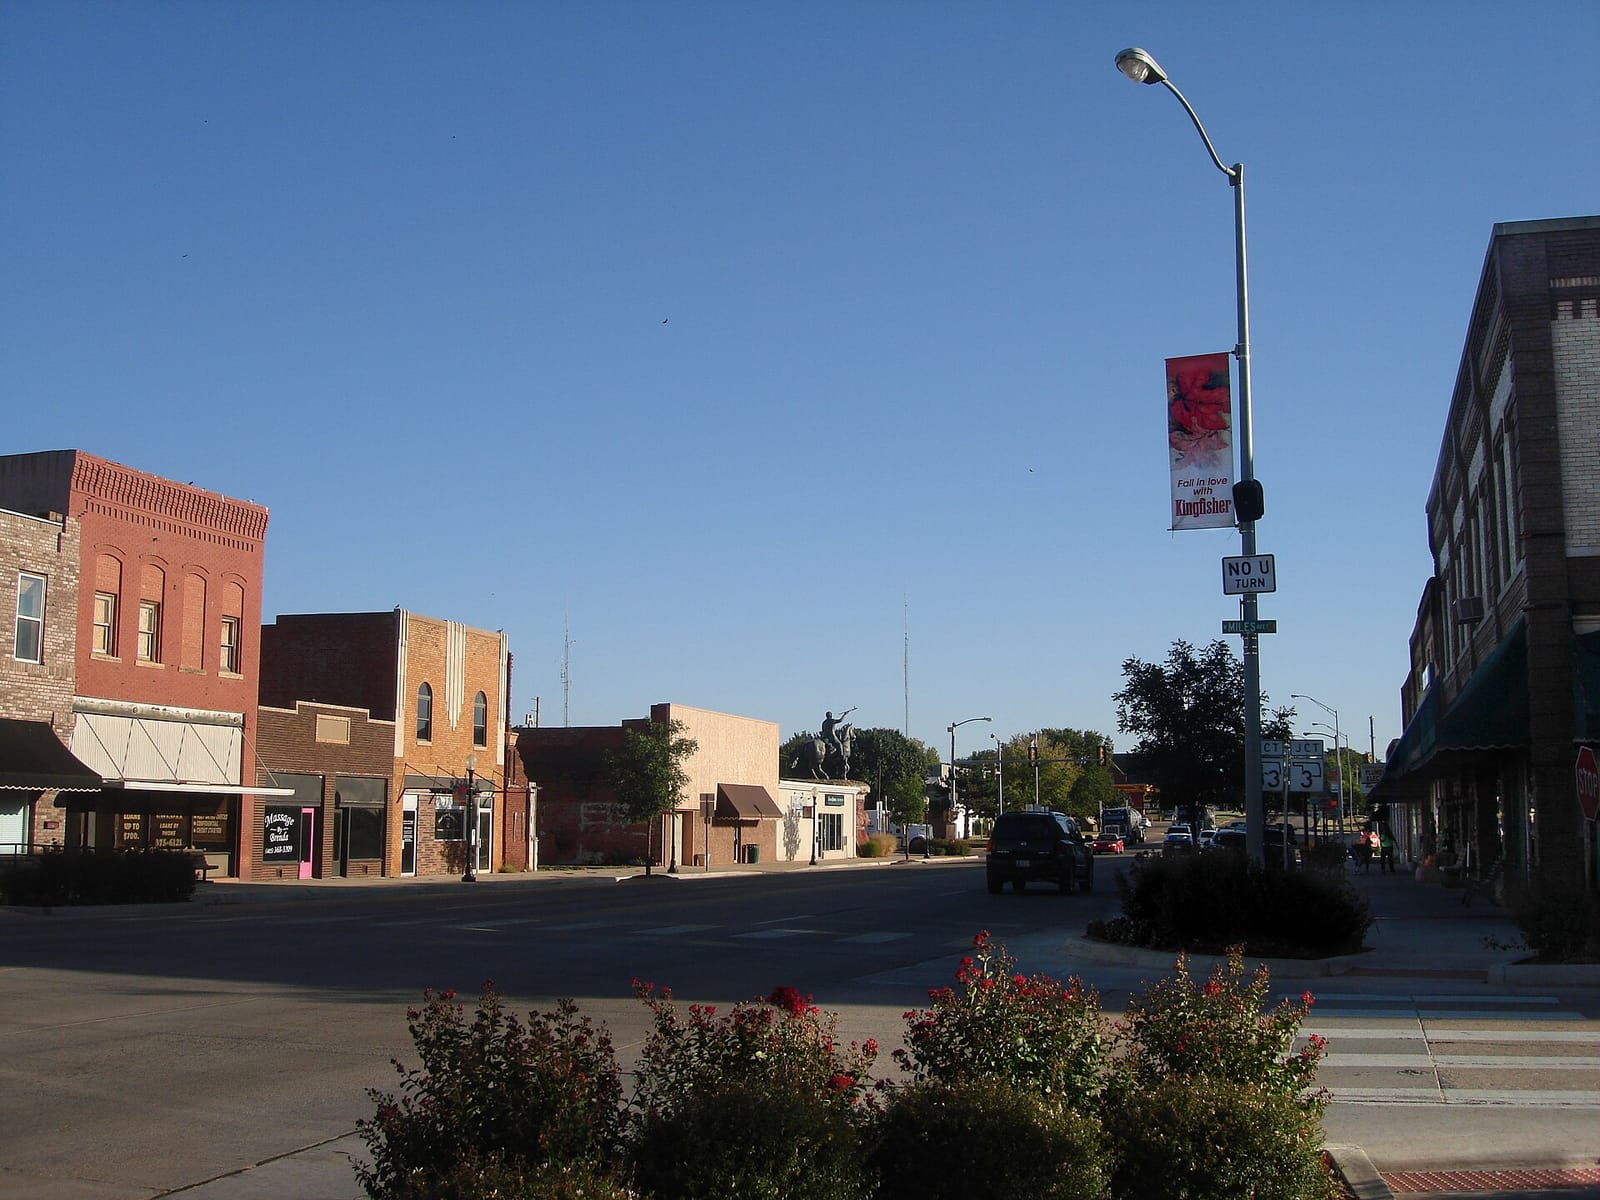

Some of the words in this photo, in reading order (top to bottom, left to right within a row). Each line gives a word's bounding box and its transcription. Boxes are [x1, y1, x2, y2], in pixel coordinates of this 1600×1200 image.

[1177, 478, 1195, 488] Fall
[1196, 478, 1205, 486] in
[1208, 477, 1228, 486] love
[1192, 486, 1213, 496] with
[1175, 497, 1232, 518] Kingfisher
[1228, 561, 1251, 576] NO
[1259, 559, 1269, 574] U
[1235, 577, 1265, 588] TURN
[1228, 621, 1256, 632] MILES
[1263, 743, 1280, 753] CT
[1295, 743, 1320, 753] JCT
[1301, 770, 1313, 788] 3
[1578, 767, 1598, 798] STOP
[264, 812, 296, 828] Massage
[124, 822, 133, 831] UP
[132, 822, 141, 831] TO
[269, 831, 289, 842] Brenda
